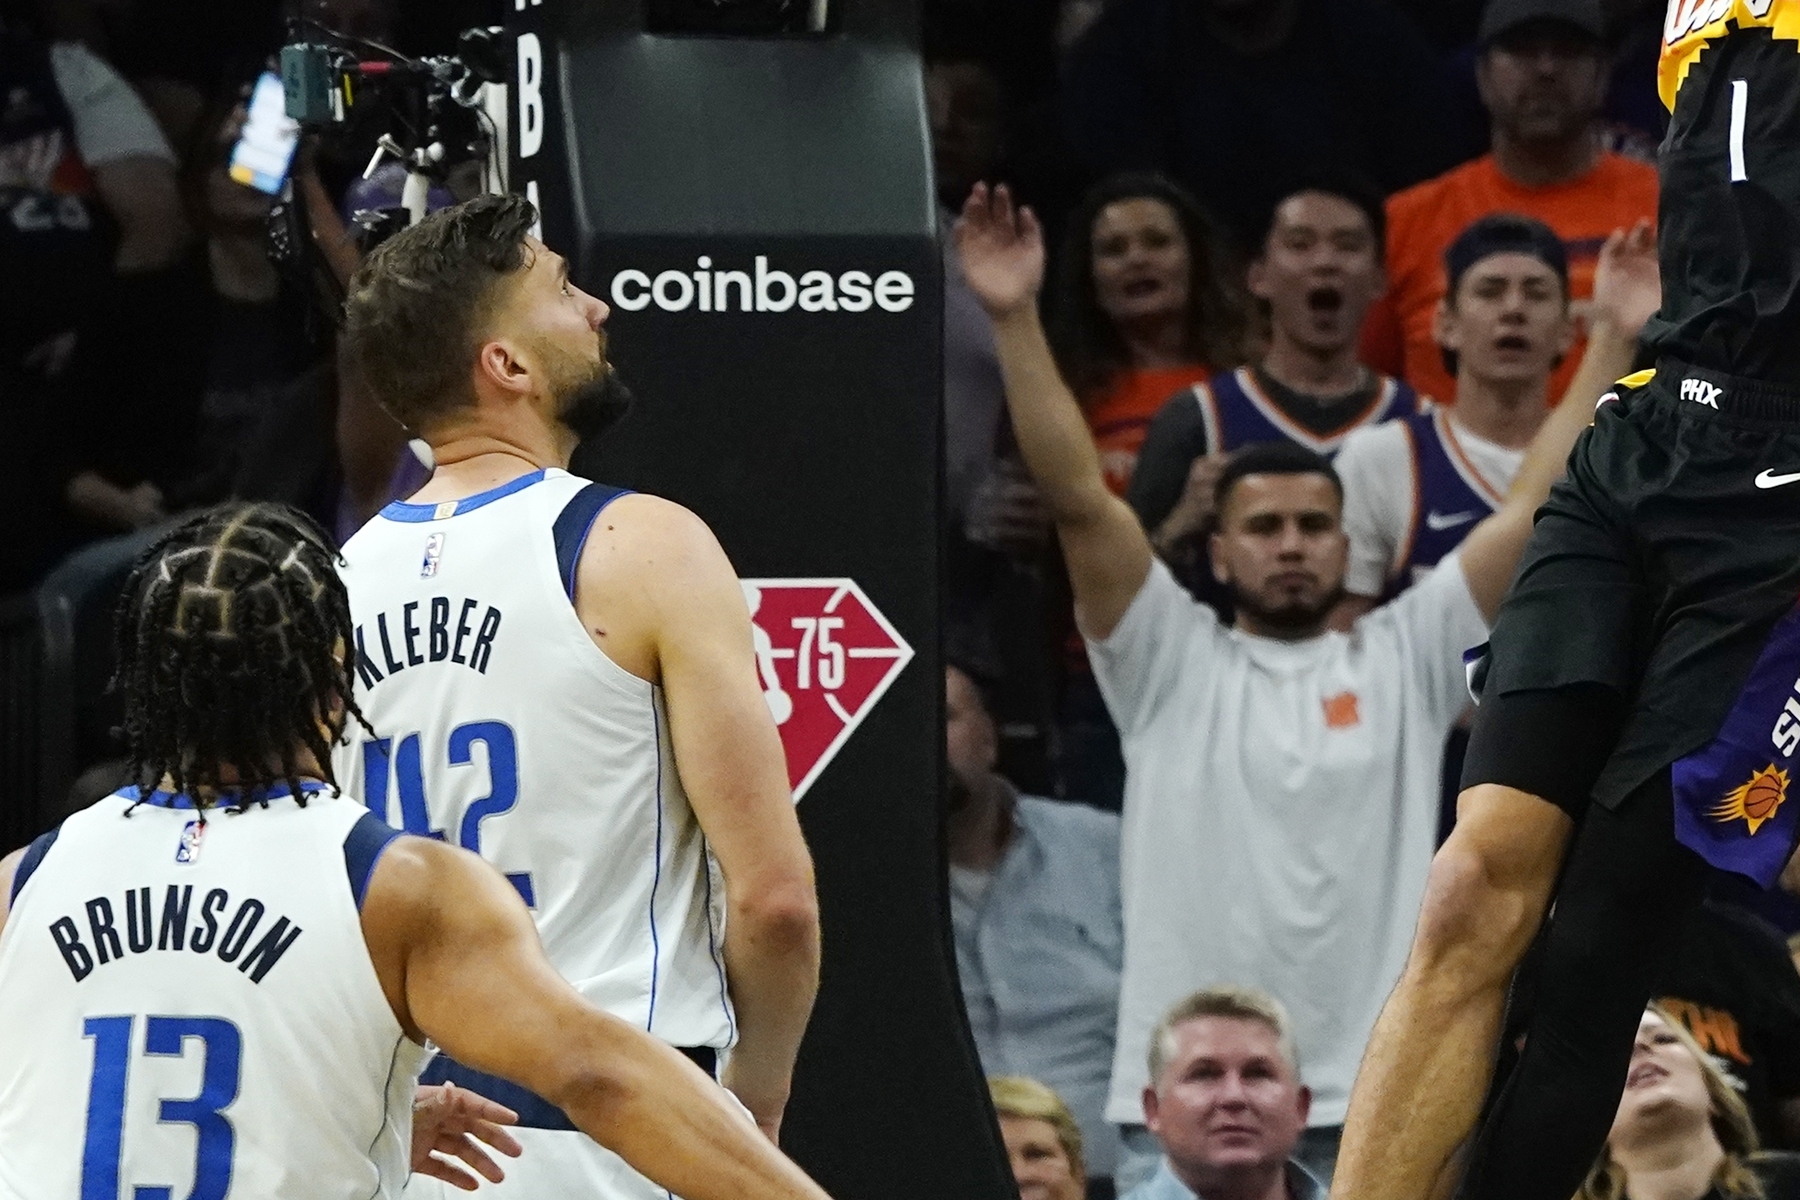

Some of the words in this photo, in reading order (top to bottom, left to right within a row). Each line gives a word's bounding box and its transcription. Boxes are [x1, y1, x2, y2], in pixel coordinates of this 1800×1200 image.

[1729, 80, 1748, 183] 1
[610, 254, 915, 313] coinbase
[1680, 378, 1724, 411] PHX
[356, 596, 501, 691] KLEBER
[791, 616, 846, 690] 75
[362, 718, 539, 911] 42
[49, 883, 303, 985] BRUNSON
[80, 1013, 245, 1200] 13
